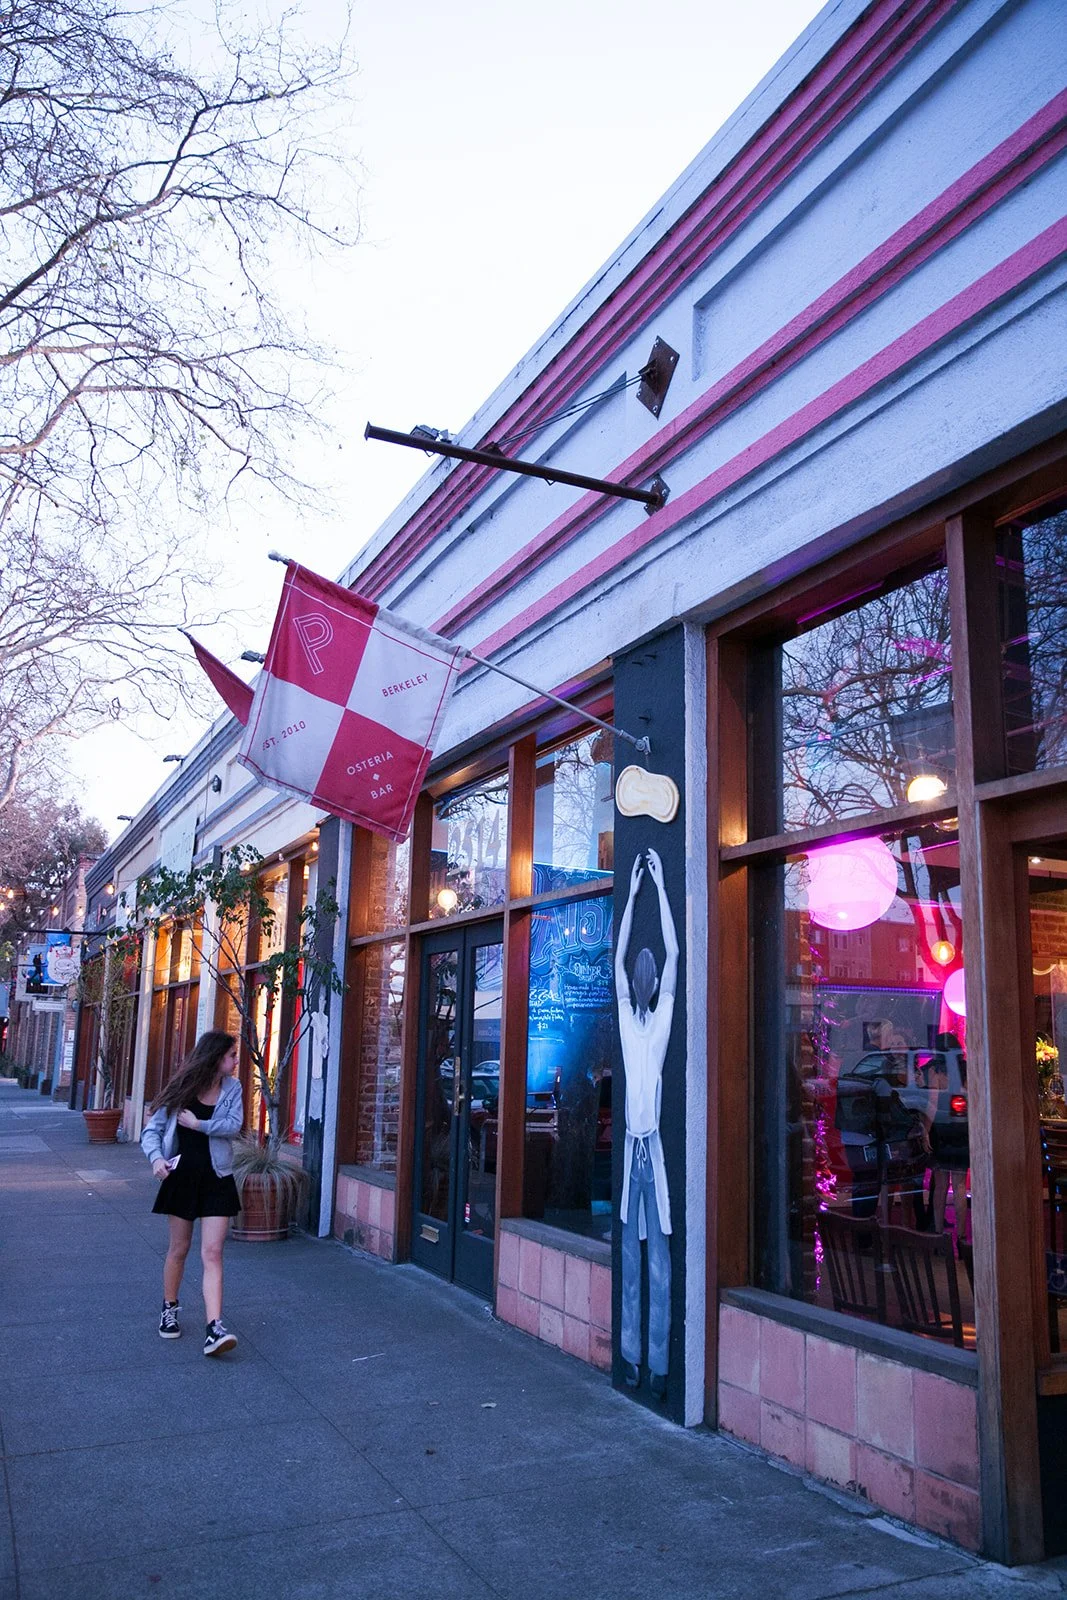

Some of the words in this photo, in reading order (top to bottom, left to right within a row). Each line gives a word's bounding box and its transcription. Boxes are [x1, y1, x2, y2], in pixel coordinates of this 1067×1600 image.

[293, 612, 334, 675] P
[382, 673, 429, 698] BERKELEY
[282, 721, 306, 740] 2010
[346, 750, 394, 776] OSTERIA
[370, 783, 394, 799] BAR
